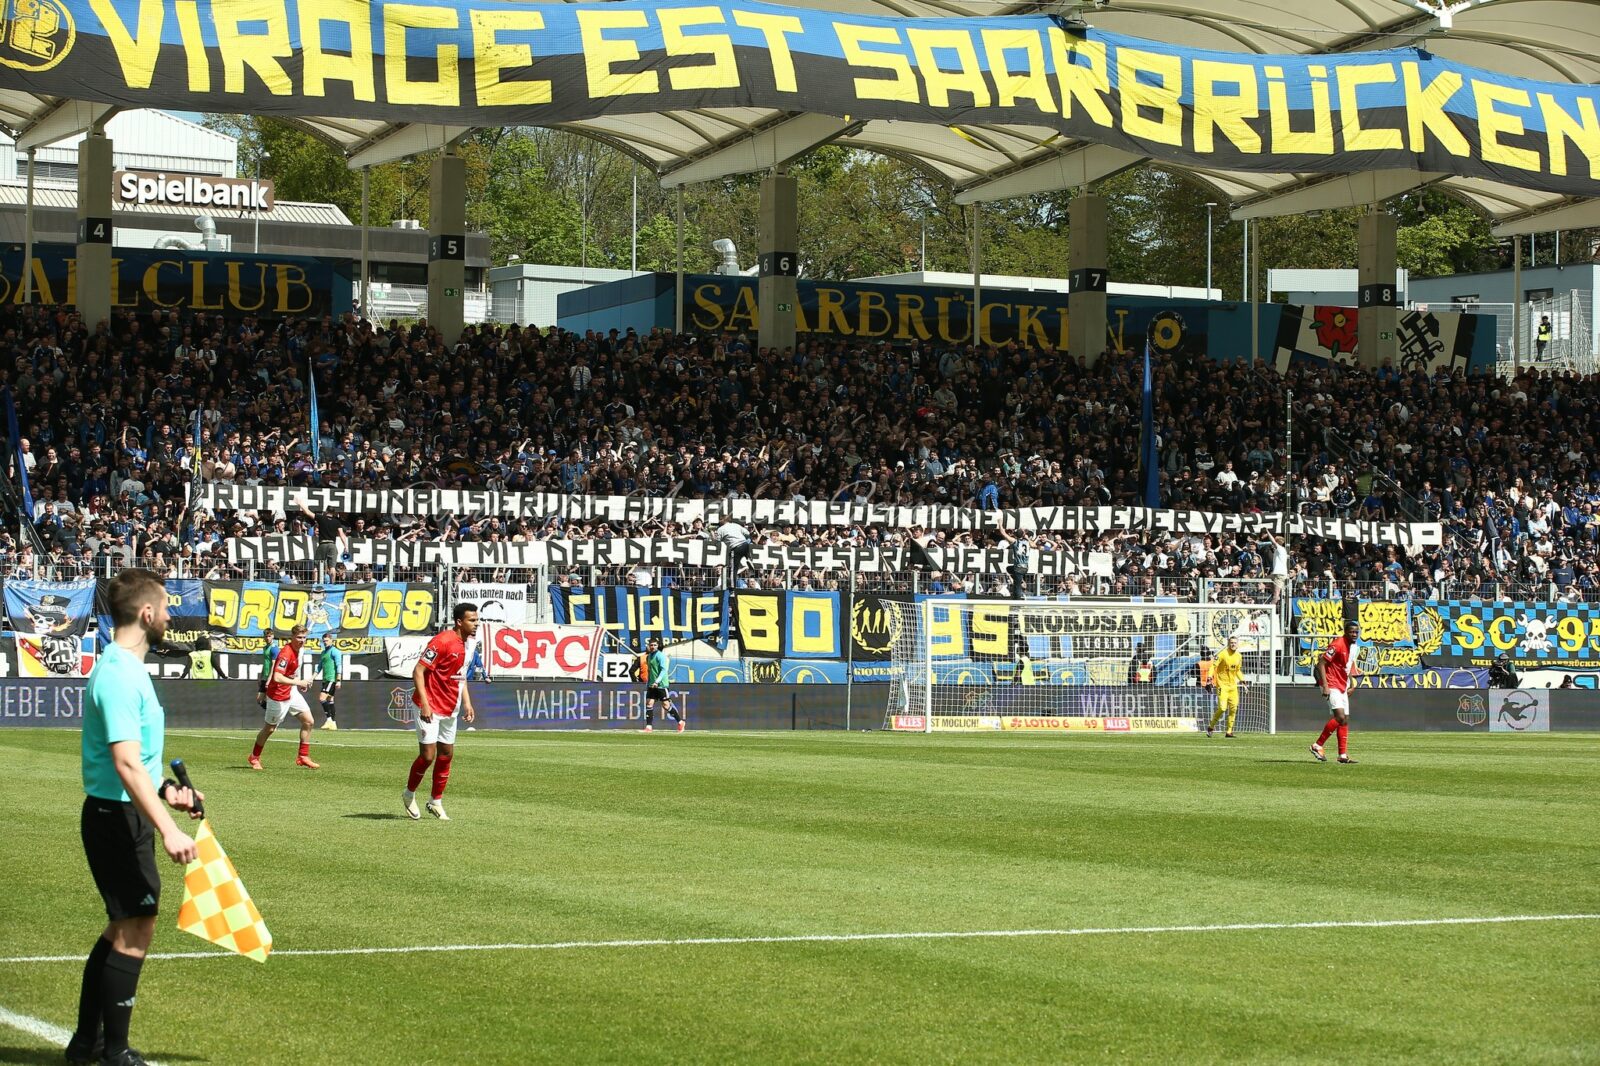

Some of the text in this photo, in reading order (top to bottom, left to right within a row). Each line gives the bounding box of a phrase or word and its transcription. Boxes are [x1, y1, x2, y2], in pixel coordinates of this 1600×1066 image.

[89, 0, 552, 107] VIRAGE
[576, 6, 804, 98] EST
[120, 172, 269, 209] Spielbank
[93, 223, 105, 238] 4
[447, 240, 458, 255] 5
[779, 257, 790, 271] 6
[1091, 273, 1101, 287] 7
[1382, 288, 1391, 301] 8
[691, 283, 1129, 355] SARBRÜCKN
[625, 495, 690, 521] AUF
[826, 500, 1020, 530] POSITIONEN
[1030, 505, 1099, 530] WAR
[1200, 511, 1413, 545] VERSPRECHEN
[235, 536, 320, 561] DAN
[347, 535, 463, 566] FANGT
[477, 541, 529, 564] MIT
[546, 539, 614, 566] DER
[625, 537, 690, 566] DES
[460, 588, 478, 599] Ossis
[568, 593, 720, 633] CLIQUE
[1454, 613, 1518, 651] SC
[492, 627, 590, 672] SFC
[607, 661, 629, 678] E2
[54, 686, 86, 718] IST
[516, 689, 591, 720] WAHRE
[598, 690, 648, 720] LIEB
[1024, 718, 1060, 729] LOTTO
[1062, 718, 1070, 729] 6
[1084, 718, 1098, 729] 49
